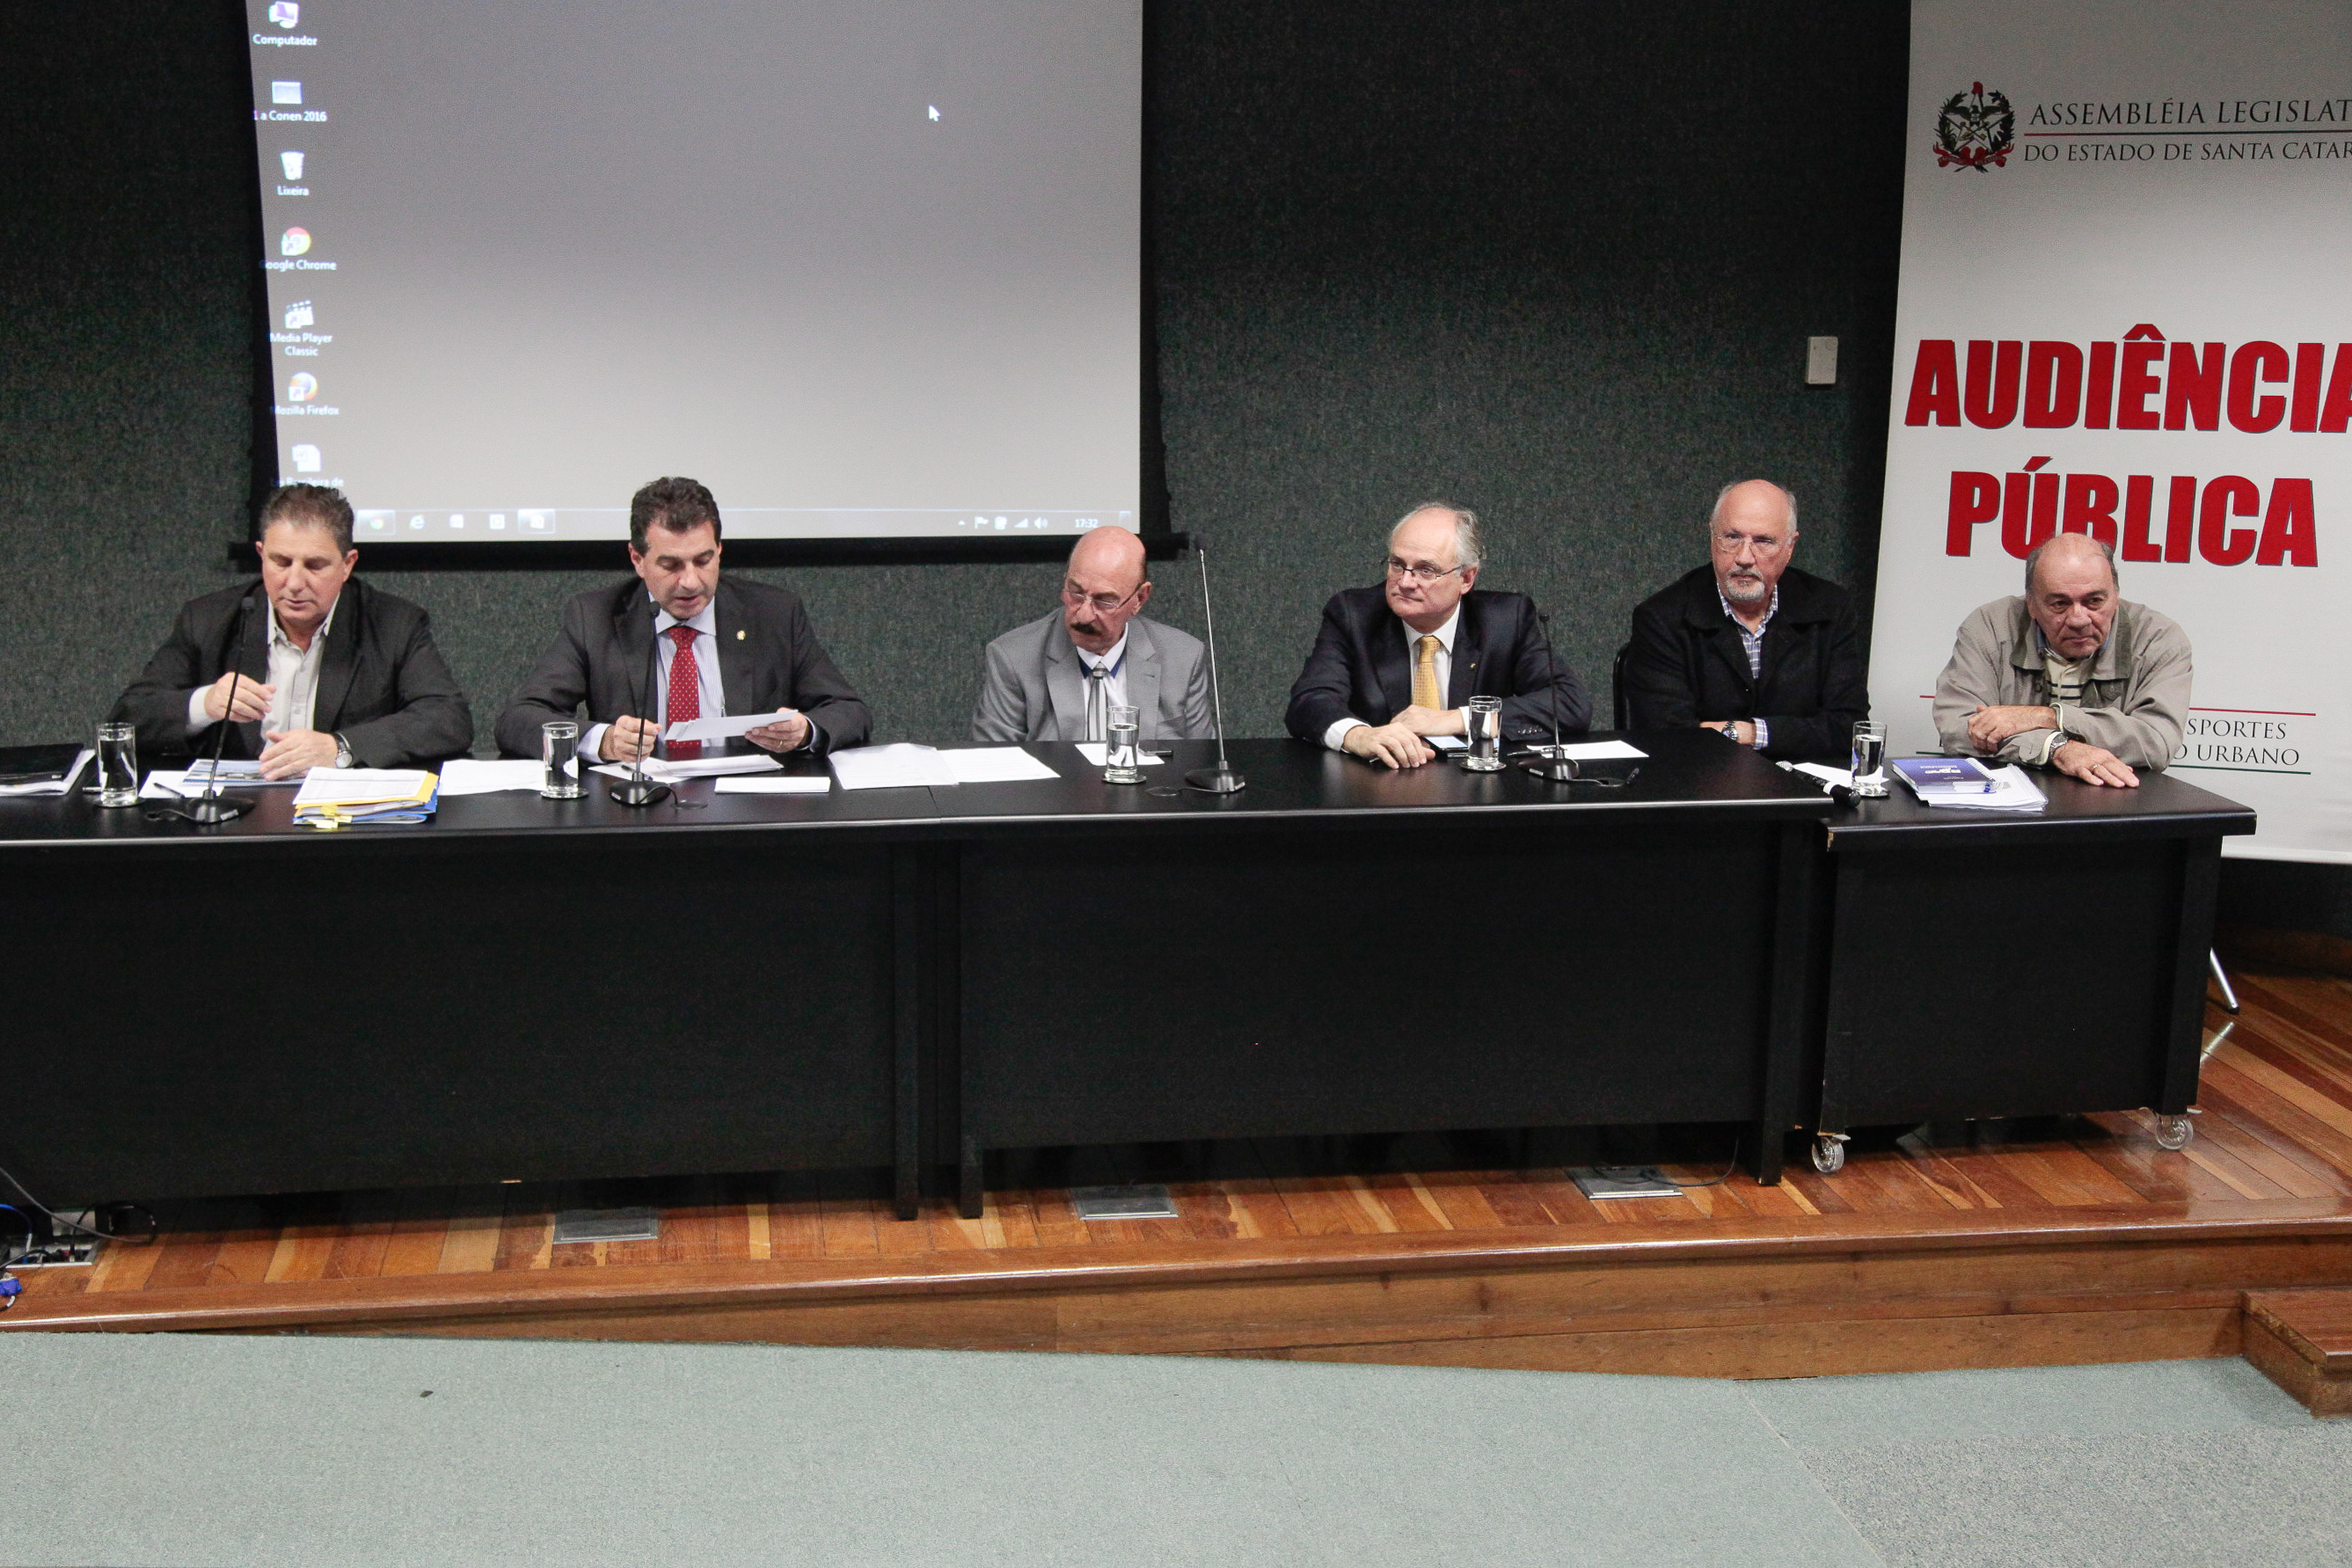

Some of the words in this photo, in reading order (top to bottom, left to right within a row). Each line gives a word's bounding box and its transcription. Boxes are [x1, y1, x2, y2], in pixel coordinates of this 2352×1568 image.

[252, 33, 318, 47] Computador
[268, 110, 302, 121] Conen
[303, 111, 327, 121] 2016
[2029, 98, 2205, 125] ASSEMBLÉIA
[2024, 144, 2059, 162] DO
[2068, 143, 2155, 161] ESTADO
[2164, 143, 2192, 161] DE
[2201, 142, 2275, 160] SANTA
[276, 185, 310, 195] Lixeira
[296, 259, 337, 270] Chrome
[302, 332, 333, 345] Player
[285, 346, 318, 356] Classic
[1904, 323, 2352, 434] AUDIÊNCIA
[307, 405, 340, 415] Firefox
[1946, 456, 2319, 567] PÚBLICA
[1075, 519, 1099, 529] 17:32
[2197, 744, 2299, 766] URBANO
